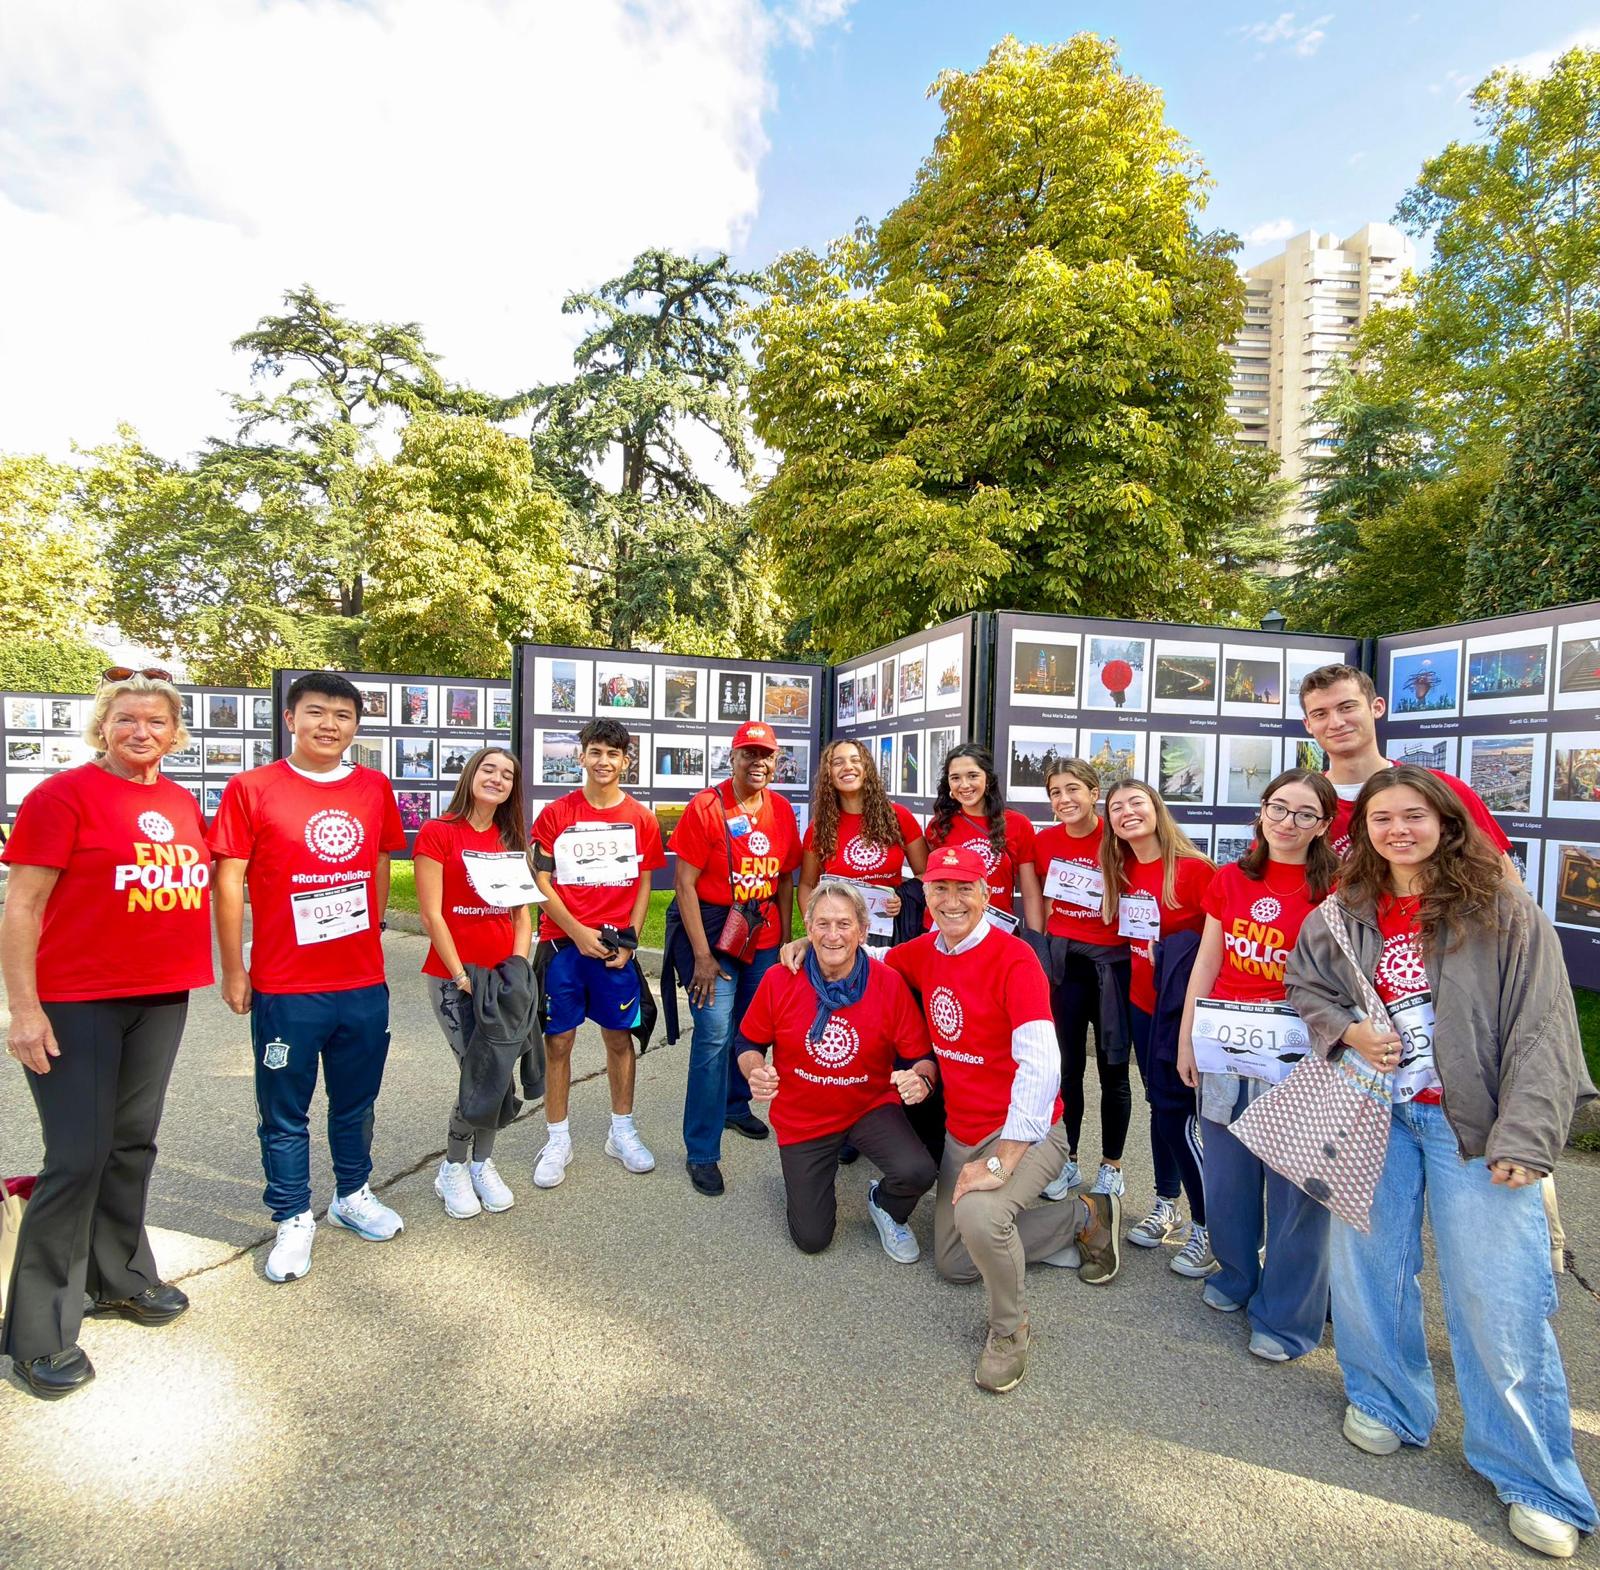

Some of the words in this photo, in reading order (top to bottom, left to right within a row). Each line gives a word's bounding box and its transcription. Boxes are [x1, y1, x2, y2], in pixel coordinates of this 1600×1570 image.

[328, 808, 349, 818] RACE
[133, 842, 199, 866] END
[338, 845, 362, 863] WORLD
[574, 840, 618, 858] 0353
[318, 853, 338, 864] RACE
[741, 856, 780, 875] END
[114, 864, 209, 890] POLIO
[1060, 871, 1092, 888] 0277
[127, 886, 202, 912] NOW
[314, 900, 352, 919] 0192
[1128, 906, 1151, 920] 0275
[1232, 918, 1284, 948] END
[1384, 934, 1406, 947] OLIO
[1230, 951, 1284, 981] NOW
[831, 1015, 848, 1026] RACE
[850, 1027, 860, 1054] VIRTUAL
[1217, 1025, 1280, 1051] 0361
[814, 1057, 831, 1068] RACE
[832, 1054, 855, 1069] WORLD
[794, 1068, 869, 1086] #RotaryPolioRace
